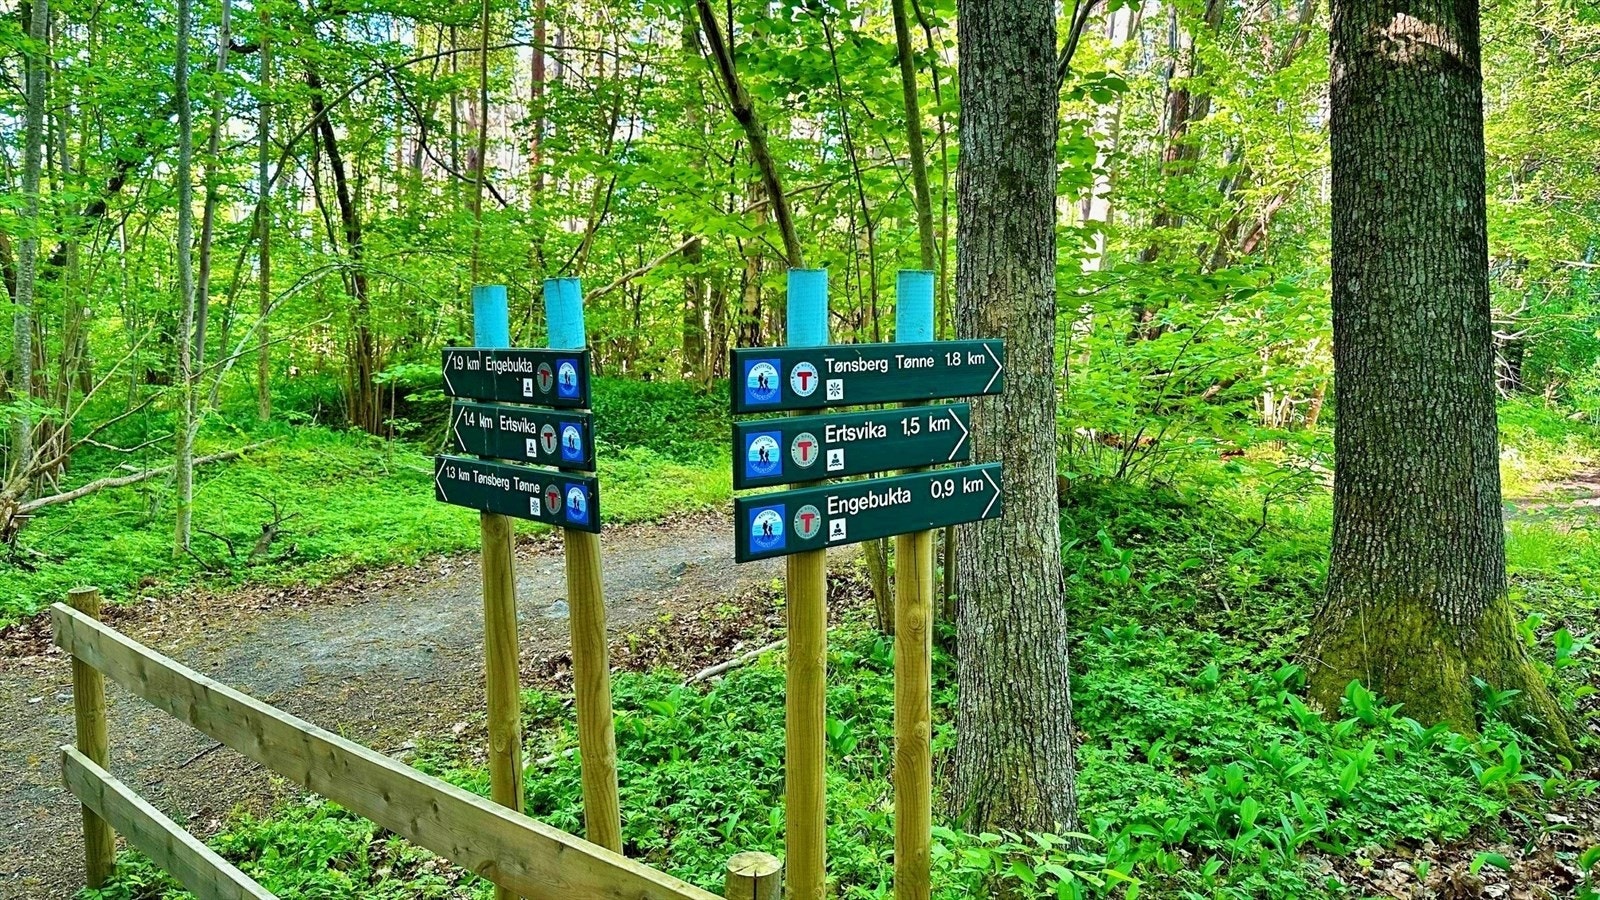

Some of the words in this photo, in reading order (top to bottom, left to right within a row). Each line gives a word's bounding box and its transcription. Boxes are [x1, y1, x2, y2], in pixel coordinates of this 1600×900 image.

[466, 356, 480, 371] km
[485, 356, 533, 375] Engebukta
[824, 356, 889, 373] Tønsberg
[895, 354, 935, 369] Tønne
[945, 351, 961, 367] 1.8
[967, 351, 985, 365] km
[540, 369, 550, 387] T
[797, 371, 812, 391] T
[479, 412, 493, 429] km
[499, 414, 537, 434] Ertsvika
[825, 421, 887, 443] Ertsvika
[901, 416, 920, 437] 1,5
[929, 415, 950, 433] km
[543, 432, 553, 449] T
[797, 441, 812, 462] T
[458, 467, 470, 482] km
[472, 469, 510, 491] Tønsberg
[513, 476, 540, 494] Tønne
[548, 492, 557, 509] T
[827, 487, 911, 516] Engebukta
[930, 479, 955, 499] 0,9
[962, 477, 984, 494] km
[800, 513, 815, 533] T
